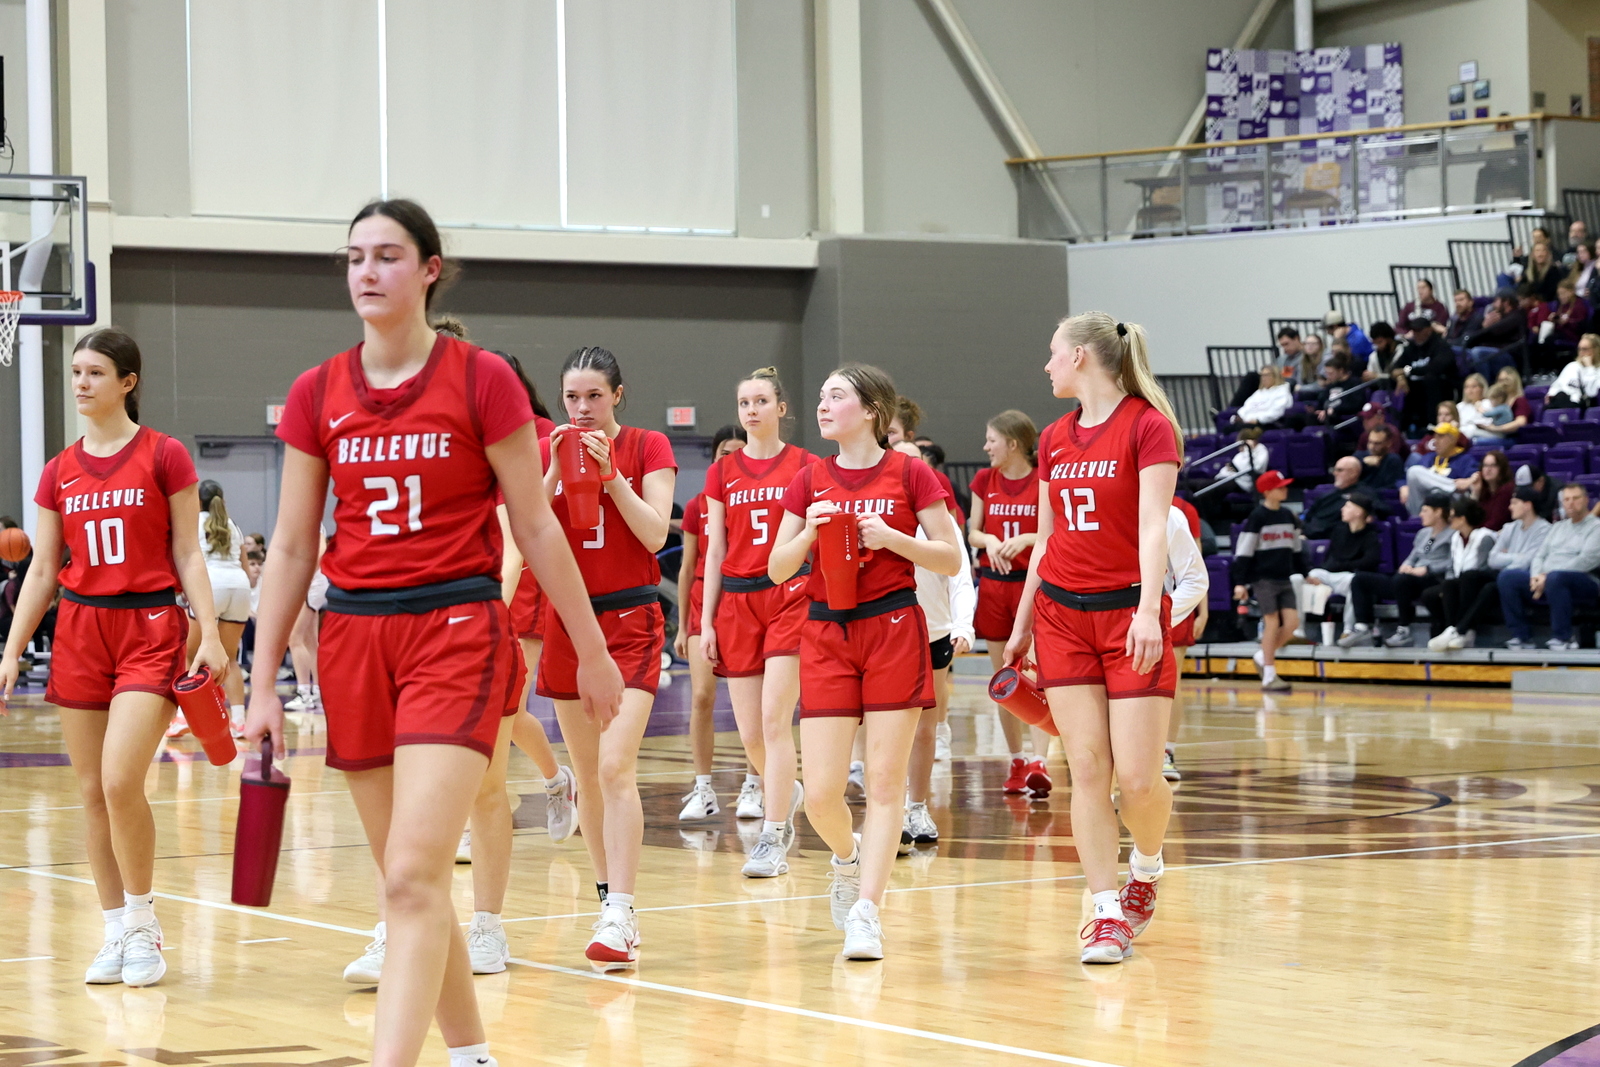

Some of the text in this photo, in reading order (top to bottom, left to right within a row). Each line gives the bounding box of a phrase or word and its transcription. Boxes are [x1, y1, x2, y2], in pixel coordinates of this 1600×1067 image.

[338, 433, 451, 464] BELLEVUE
[65, 488, 145, 515] BELLEVUE
[363, 474, 423, 536] 21
[729, 487, 788, 507] BELLEVU
[989, 503, 1037, 516] BELLEVUE
[1060, 487, 1100, 531] 12
[84, 517, 126, 567] 10
[750, 508, 769, 546] 5
